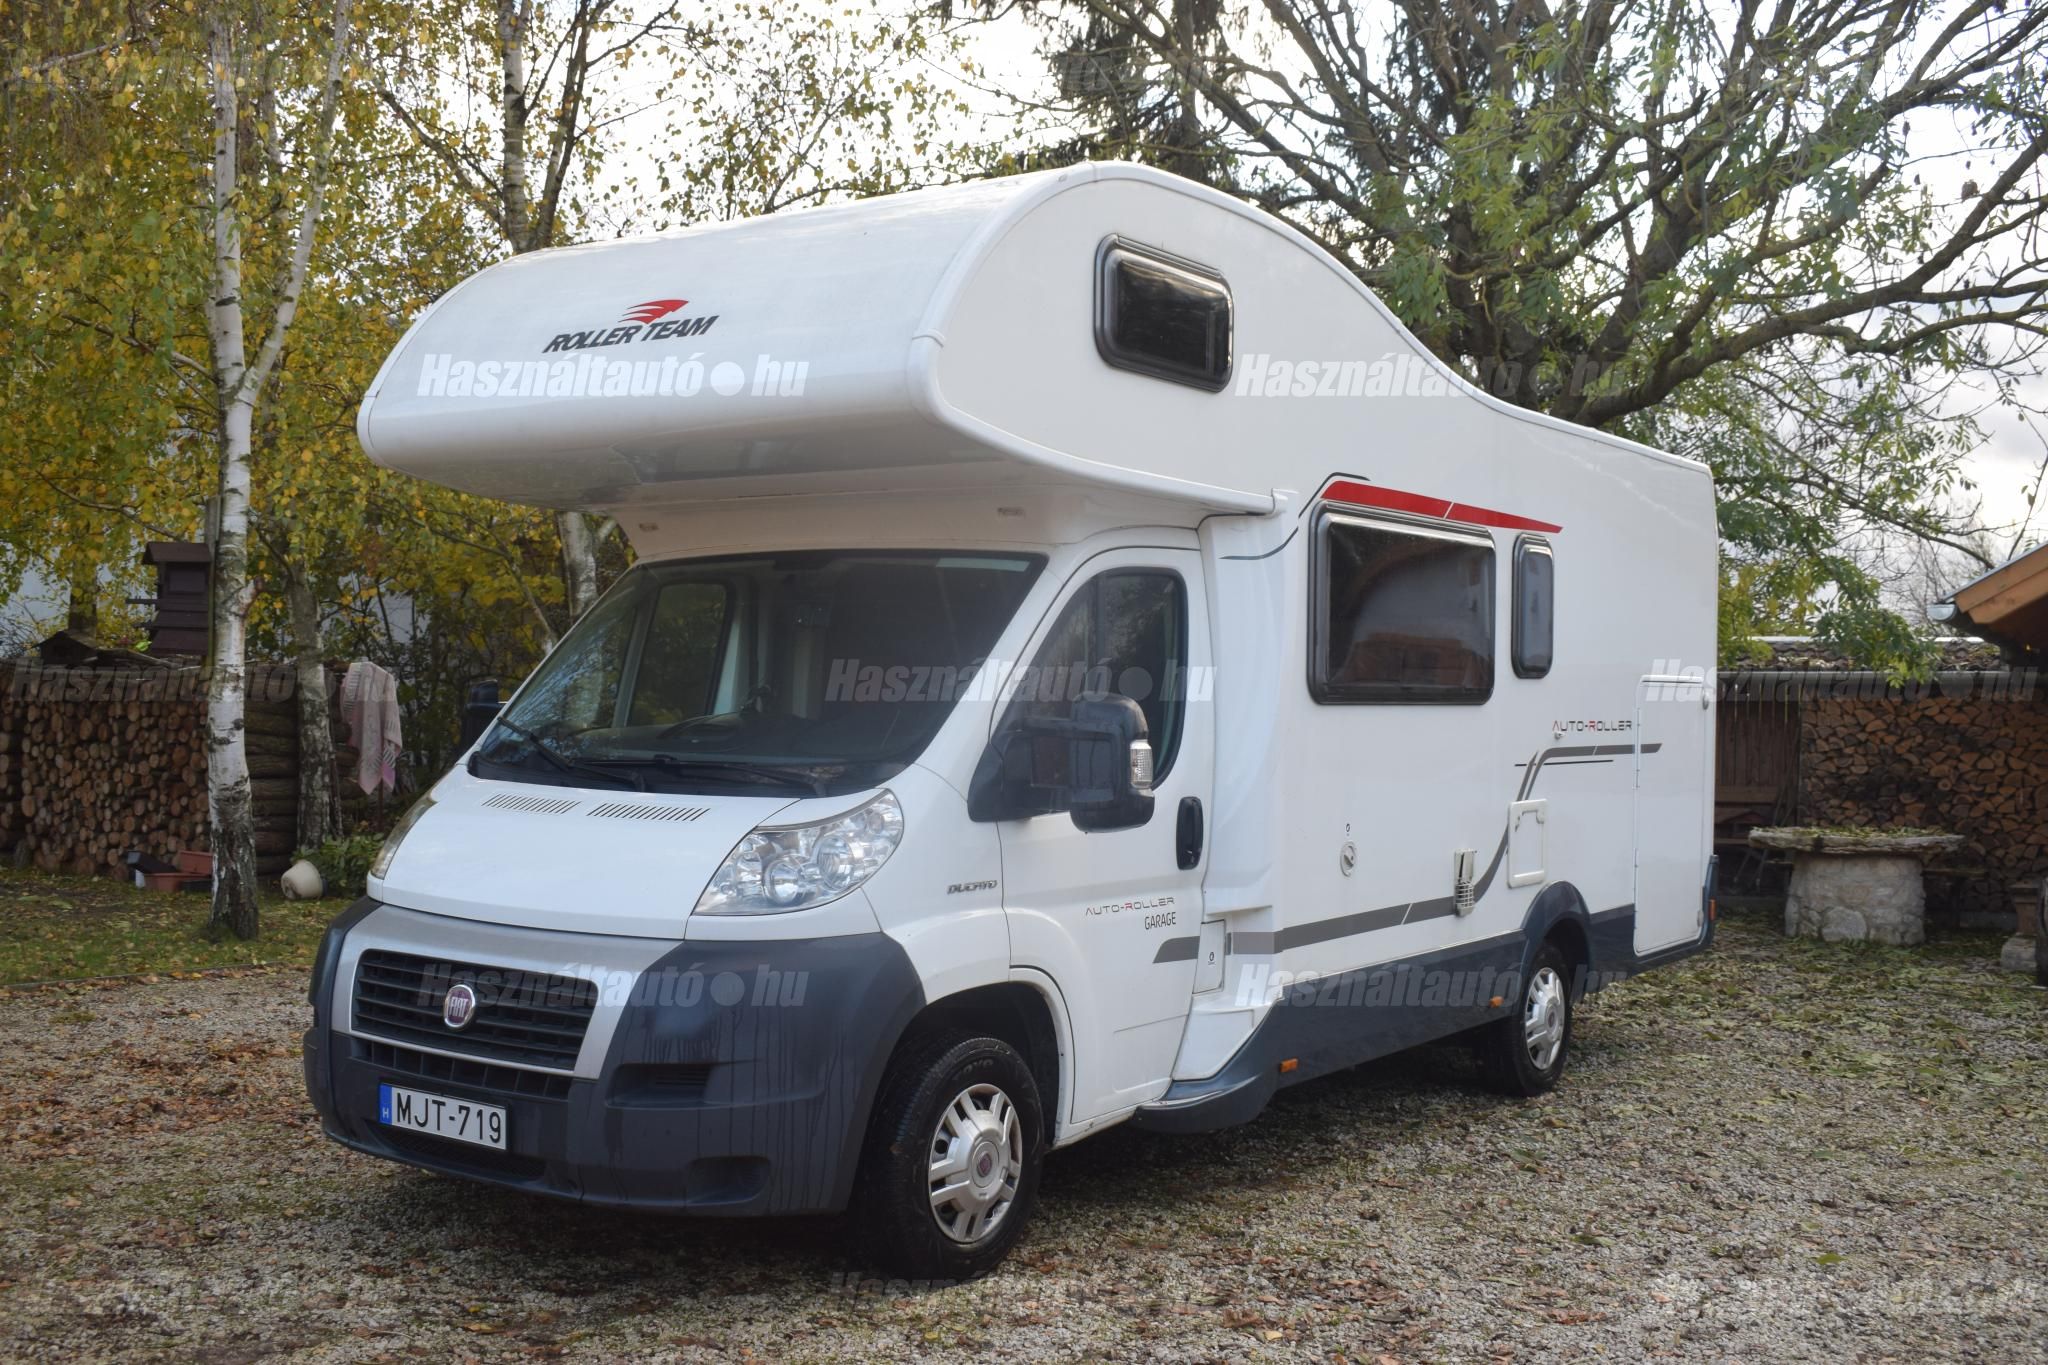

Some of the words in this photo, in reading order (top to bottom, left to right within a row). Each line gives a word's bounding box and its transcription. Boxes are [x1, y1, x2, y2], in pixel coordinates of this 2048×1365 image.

[542, 325, 643, 354] ROLLER
[641, 315, 720, 342] TEAM
[1552, 720, 1632, 732] AUTO-ROLLER
[1085, 897, 1175, 916] AUTO-ROLLER
[1144, 911, 1176, 930] GARAGE
[450, 996, 468, 1018] FIAT
[396, 1092, 502, 1144] MJT-719
